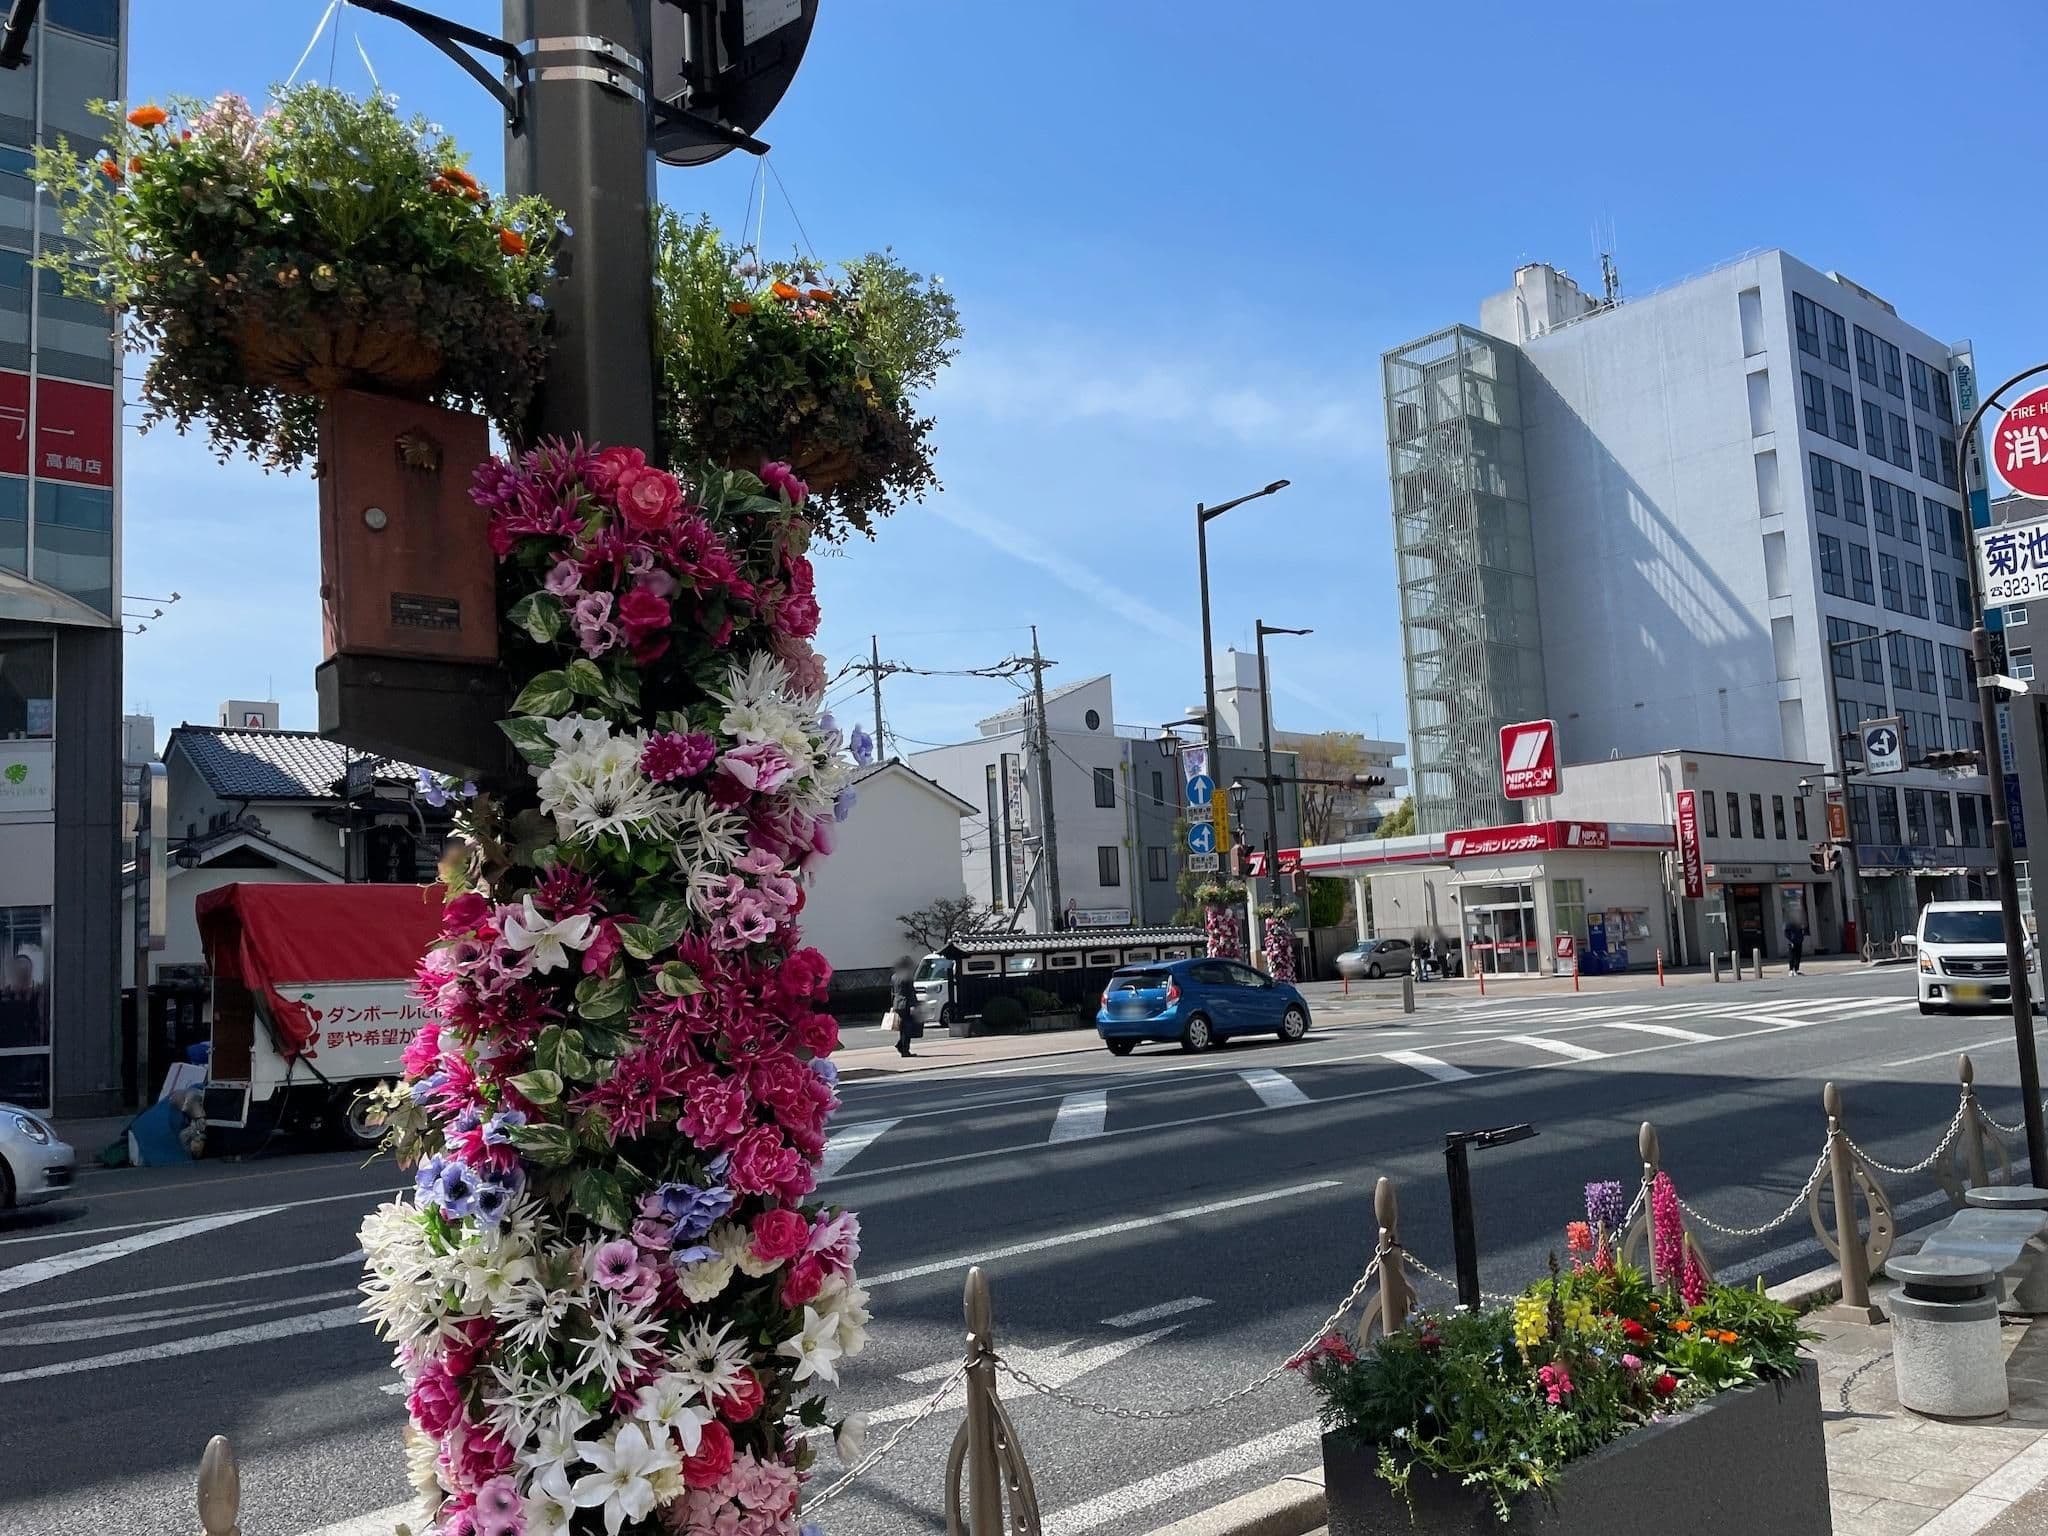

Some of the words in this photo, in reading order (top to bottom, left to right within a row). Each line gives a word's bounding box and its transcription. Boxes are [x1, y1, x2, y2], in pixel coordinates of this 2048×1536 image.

[2010, 405, 2036, 421] FIRE
[2003, 426, 2048, 471] 消
[45, 452, 103, 475] 高崎店
[1984, 527, 2048, 577] 菊池
[1506, 768, 1553, 785] NIPPON
[1582, 830, 1606, 842] NIPPON
